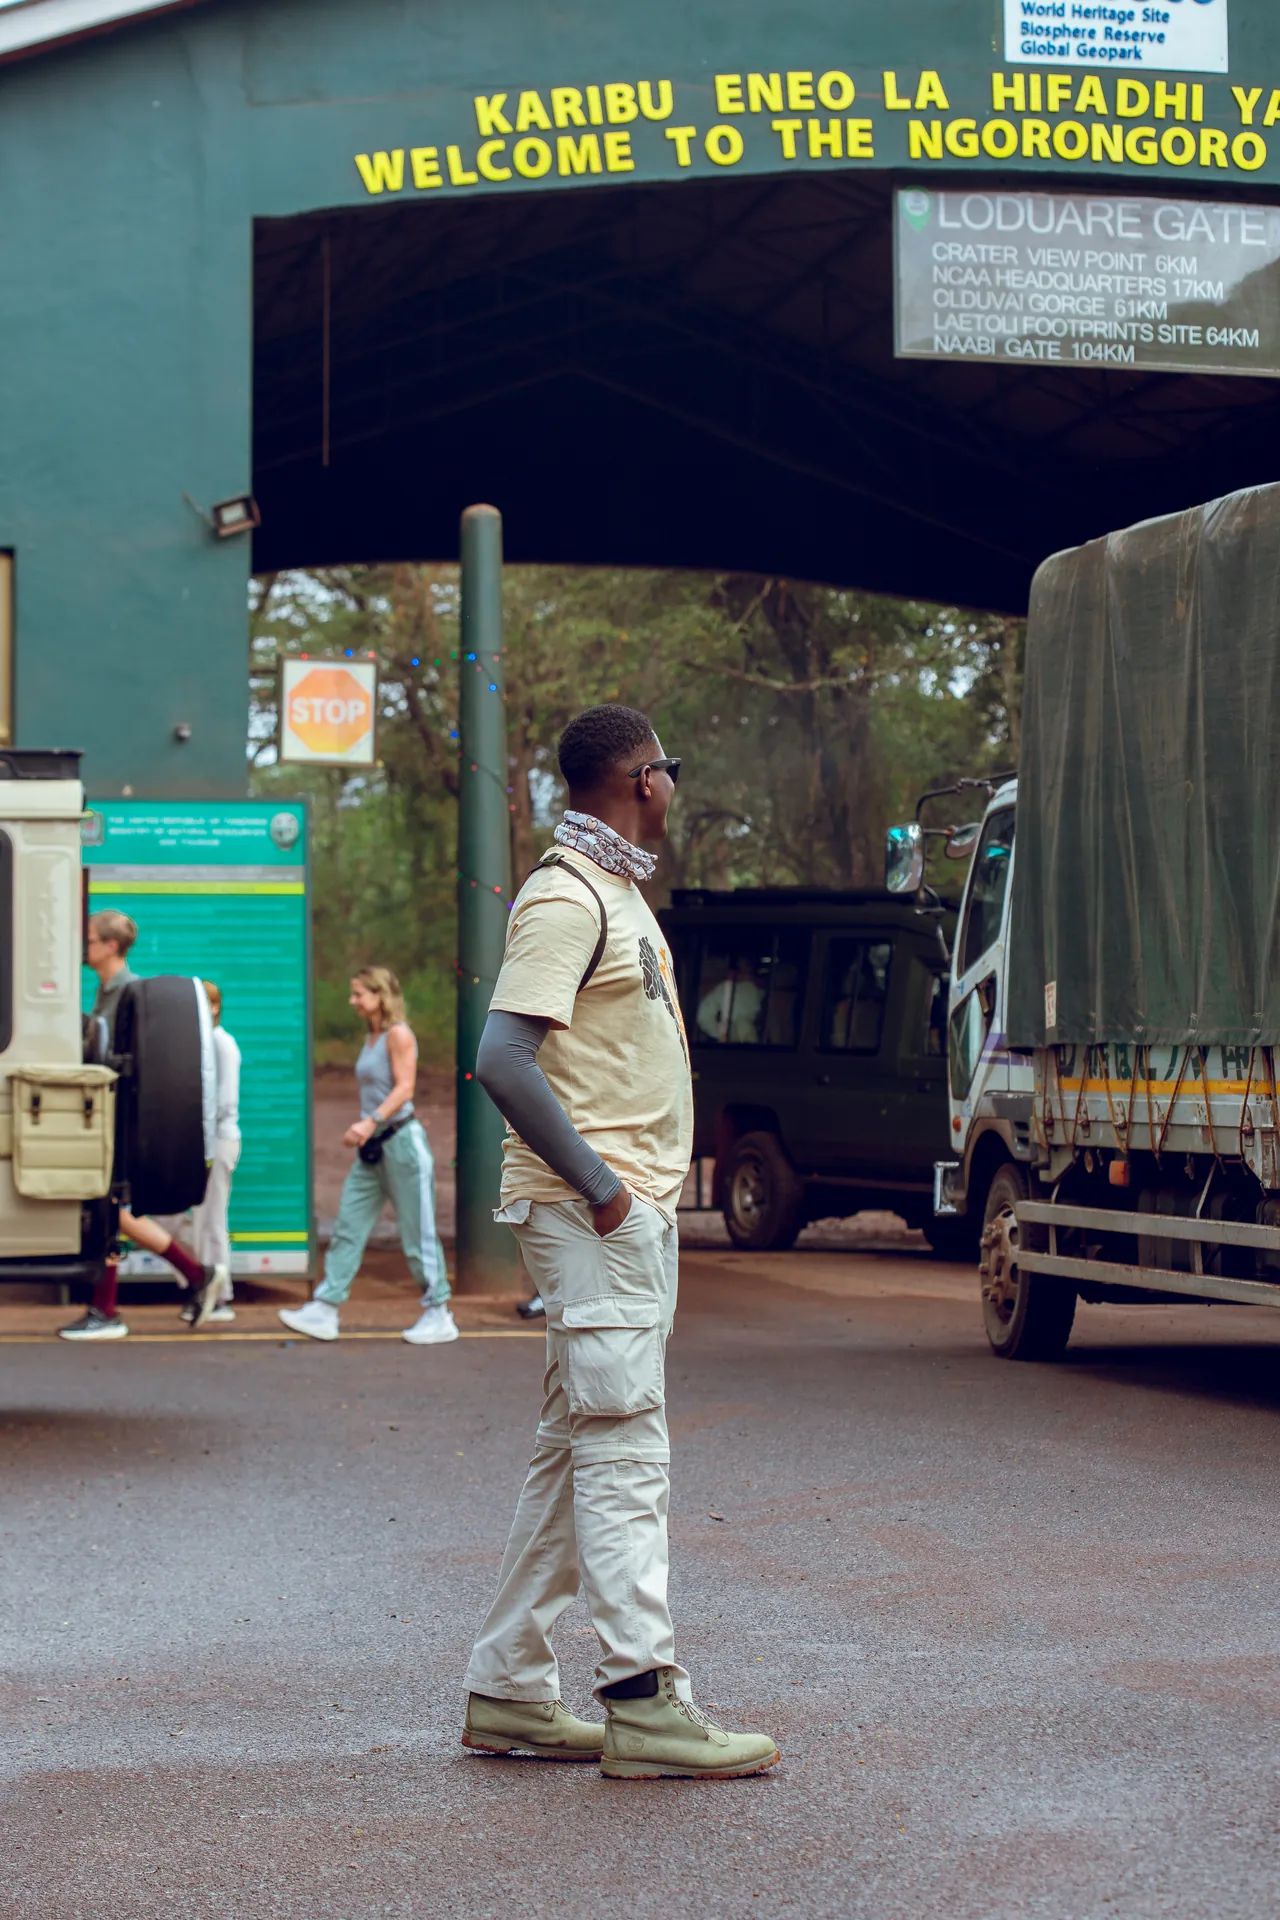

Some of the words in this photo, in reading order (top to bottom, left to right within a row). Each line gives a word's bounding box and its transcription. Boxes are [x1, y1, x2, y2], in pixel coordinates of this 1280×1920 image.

[1021, 2, 1065, 17] World
[1071, 5, 1135, 24] Heritage
[1142, 8, 1170, 23] Site
[1021, 22, 1097, 40] Biosphere
[1104, 27, 1165, 44] Reserve
[1021, 41, 1070, 57] Global
[1076, 44, 1143, 61] Geopark
[474, 80, 674, 136] KARIBU
[715, 71, 856, 115] ENEO
[883, 71, 949, 110] LA
[992, 73, 1204, 122] HIFADHI
[355, 131, 635, 194] WELCOME
[665, 125, 744, 167] TO
[772, 118, 875, 159] THE
[909, 119, 1267, 171] NGORONGORO
[938, 193, 1144, 240] LODUARE
[1153, 205, 1267, 246] GATE
[932, 242, 1018, 265] CRATER
[1026, 248, 1081, 268] VIEW
[1084, 250, 1147, 273] POINT
[1155, 255, 1198, 275] 6KM
[932, 265, 992, 287] NCAA
[995, 268, 1167, 297] HEADQUARTERS
[1172, 278, 1224, 300] 17KM
[933, 288, 1023, 312] OLDUVAI
[1028, 293, 1106, 316] GORGE
[1114, 298, 1168, 321] 61KM
[933, 312, 1018, 334] LAETOLI
[1022, 315, 1154, 344] FOOTPRINTS
[1157, 324, 1203, 346] SITE
[1205, 326, 1260, 348] 64KM
[933, 334, 996, 356] NAABI
[1004, 338, 1061, 360] GATE
[1071, 342, 1136, 364] 104KM
[292, 697, 366, 724] STOP
